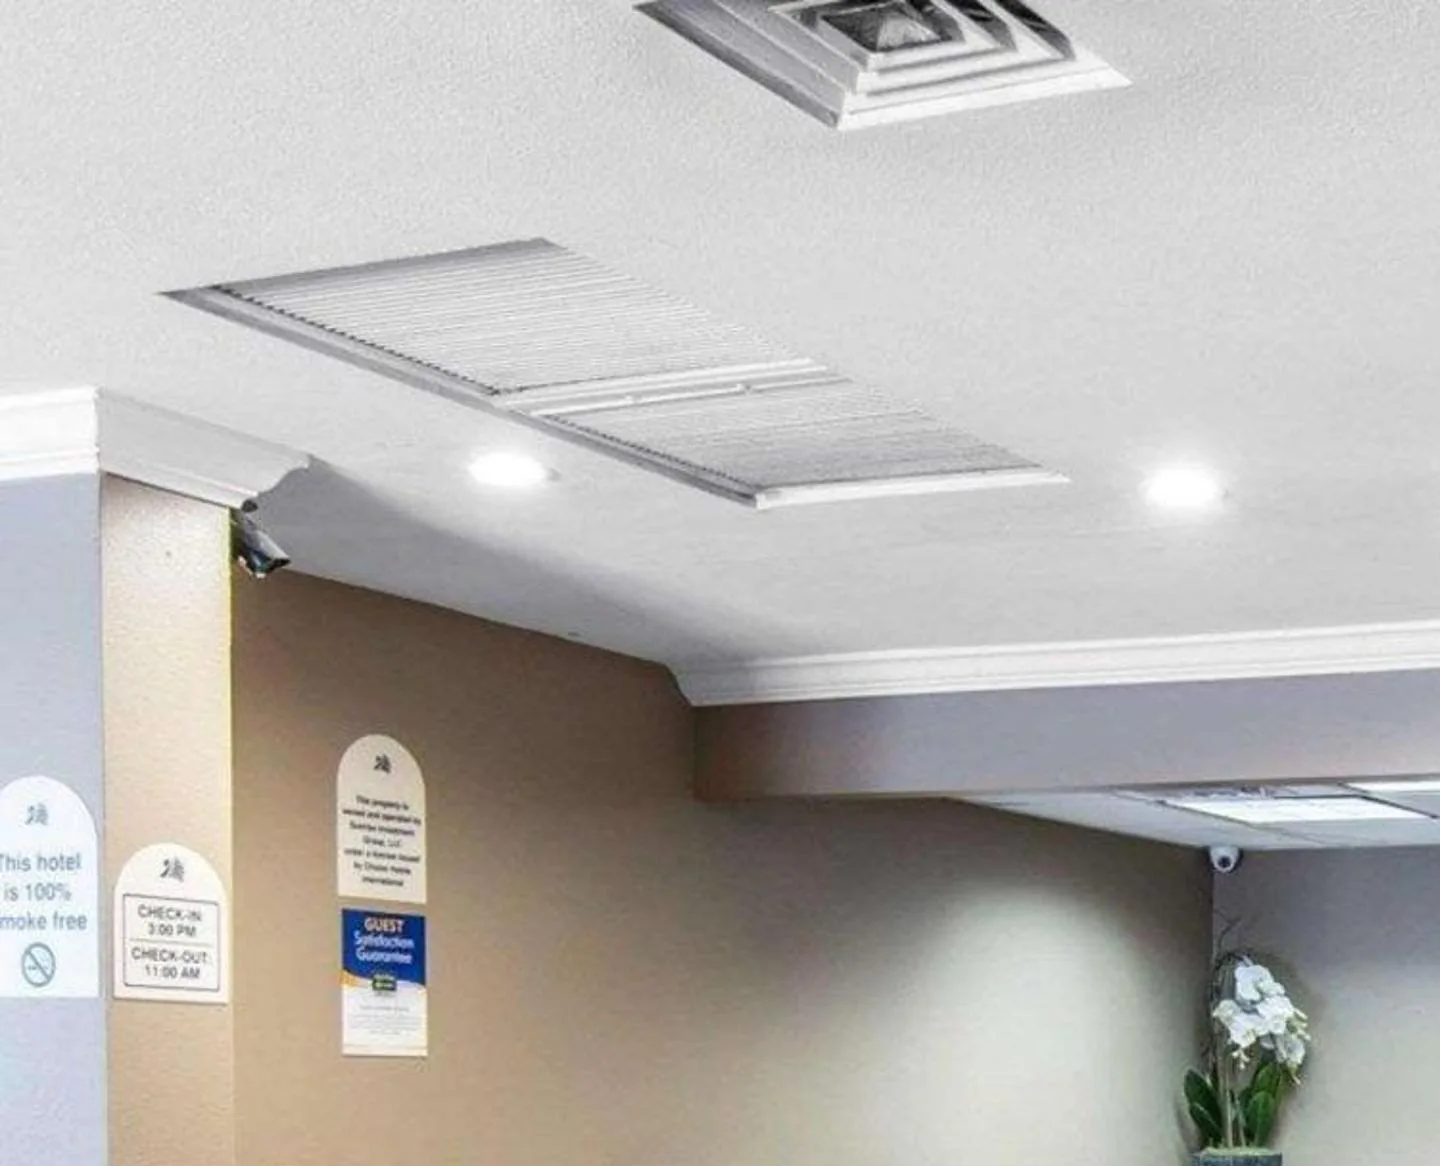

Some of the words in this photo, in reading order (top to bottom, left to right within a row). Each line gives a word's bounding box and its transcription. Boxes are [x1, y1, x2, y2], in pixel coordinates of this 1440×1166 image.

[37, 851, 82, 872] hotel
[4, 882, 19, 901] is
[25, 882, 72, 901] 100%
[0, 910, 47, 930] moke
[52, 910, 87, 930] free
[364, 917, 406, 933] GUEST
[176, 923, 197, 937] PM
[180, 966, 201, 979] AM
